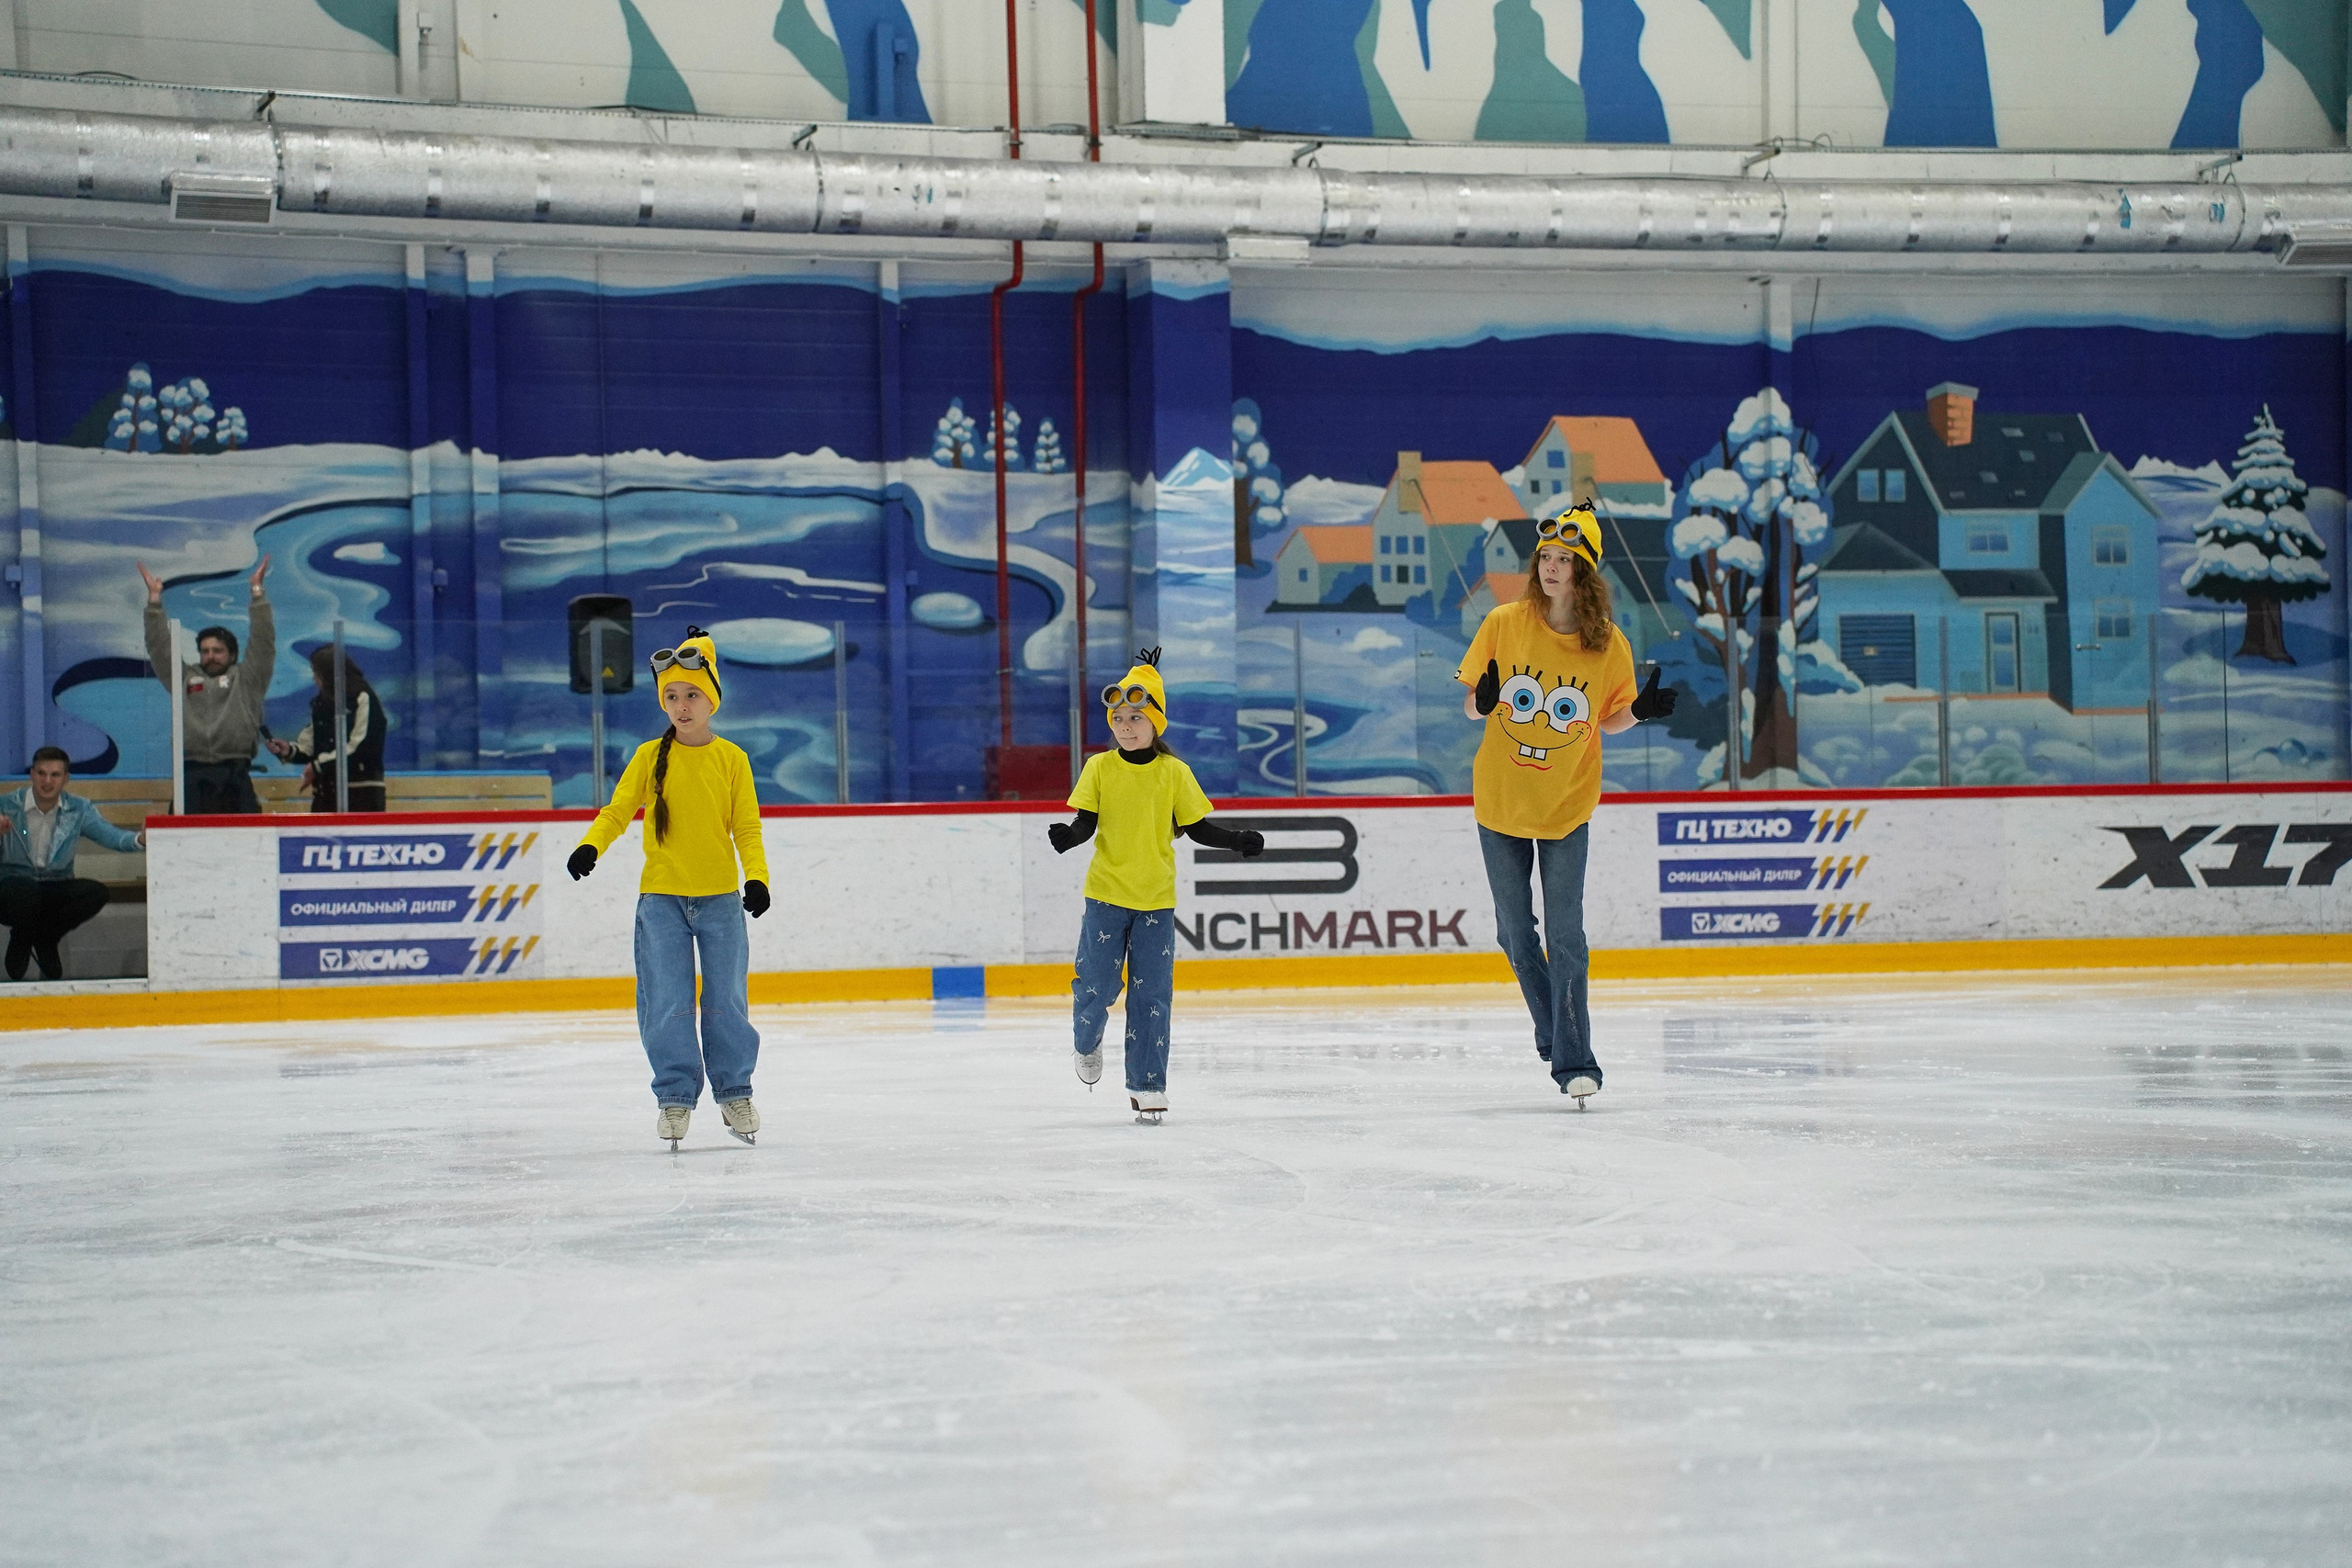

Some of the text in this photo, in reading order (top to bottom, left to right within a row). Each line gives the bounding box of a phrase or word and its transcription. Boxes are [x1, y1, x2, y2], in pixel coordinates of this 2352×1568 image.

[1676, 817, 1792, 842] ГЦ ТЕХНО
[302, 842, 446, 870] ГЦ ТЕХНО
[1668, 867, 1802, 884] ОФИЦИАЛЬНЫЙ ДИЛЕР
[290, 898, 457, 917] ОФИЦИАЛЬНЫЙ ДИЛЕР
[1174, 908, 1468, 952] NCHMARK
[1712, 912, 1781, 933] XCMG
[344, 947, 429, 972] XCMG
